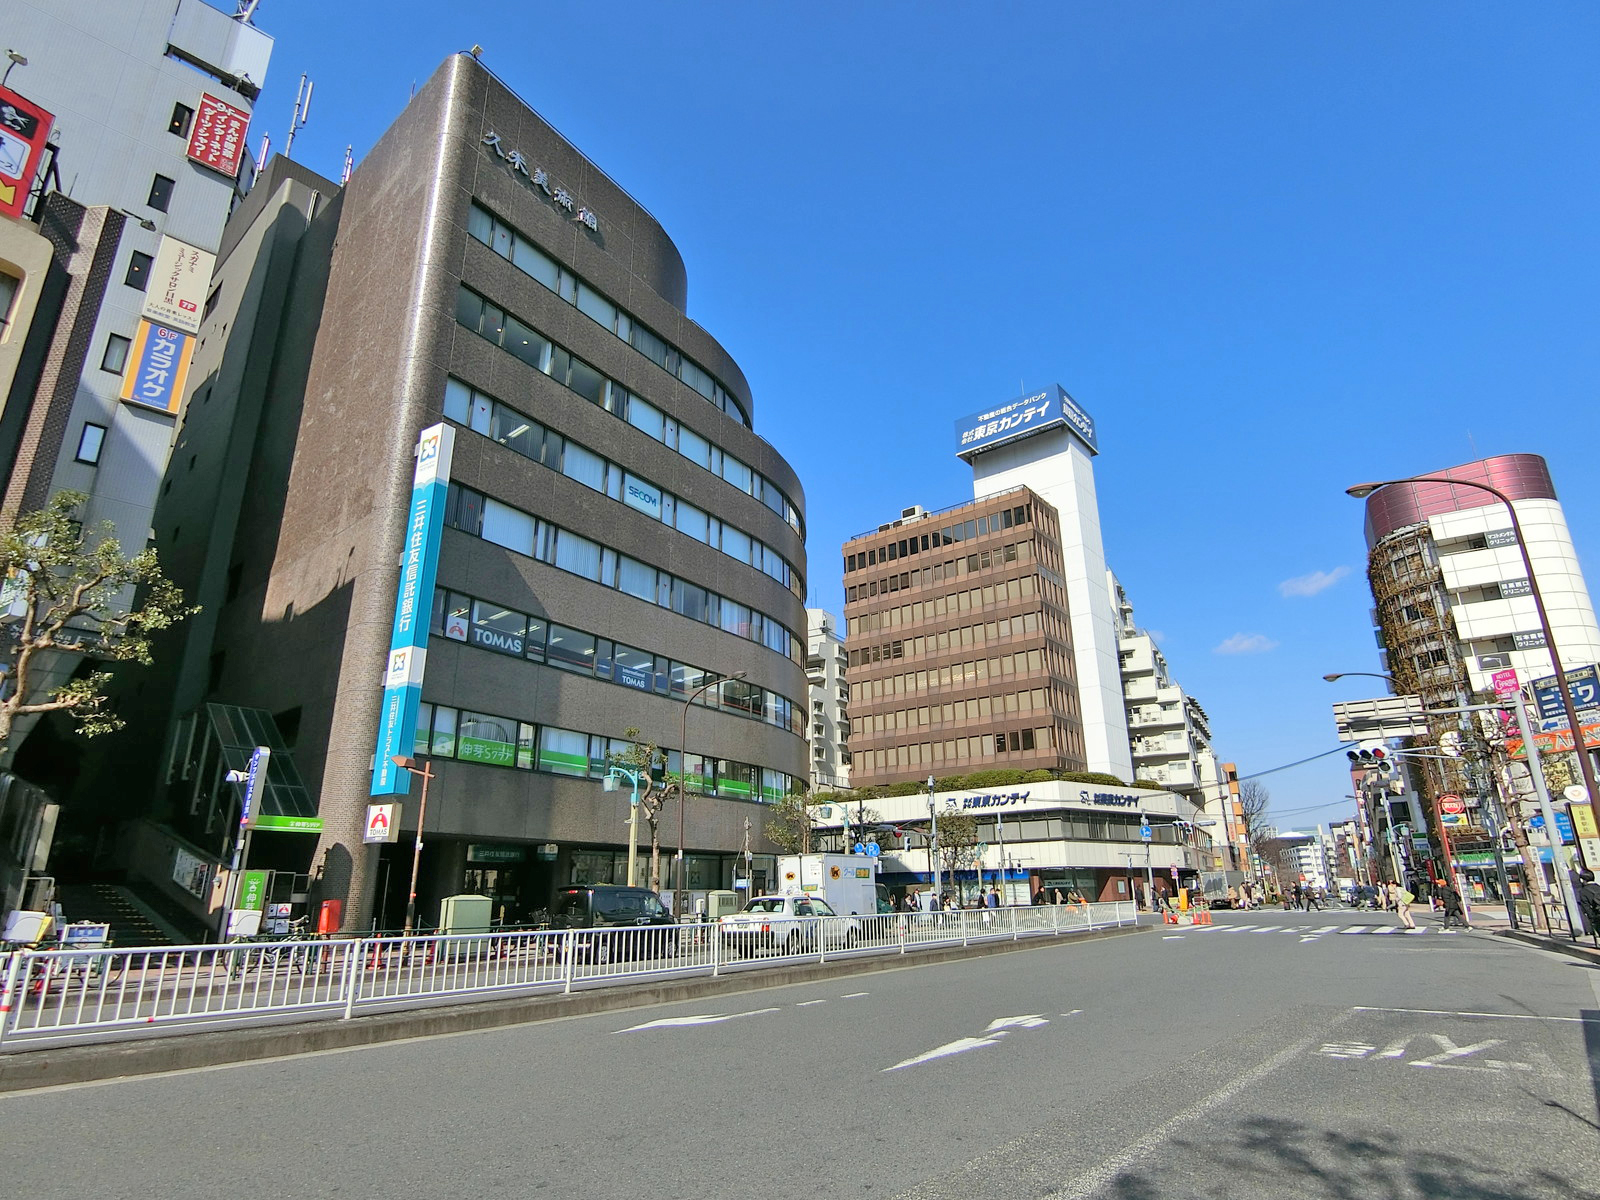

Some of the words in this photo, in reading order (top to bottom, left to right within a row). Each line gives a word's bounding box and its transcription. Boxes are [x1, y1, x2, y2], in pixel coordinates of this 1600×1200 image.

[216, 102, 235, 116] 9F
[208, 115, 228, 162] インターネット
[222, 120, 241, 159] まんが喫茶
[480, 128, 598, 232] 久米美術館
[188, 251, 200, 274] スガナミ
[163, 247, 185, 306] ミュージックサロン目黒
[181, 301, 195, 312] 7F
[157, 328, 178, 341] 6F
[142, 338, 176, 398] カラオケ
[973, 400, 1051, 441] 東京カンテイ
[628, 485, 657, 507] SECOM
[1489, 537, 1516, 545] クリニック
[399, 499, 428, 633] 三井住友信託銀行
[1503, 587, 1530, 595] クリニック
[474, 627, 522, 653] TOMAS
[1517, 639, 1546, 647] クリニック
[622, 675, 645, 688] TOMAS
[972, 791, 1031, 809] 東京カンテイ
[370, 828, 388, 836] TOMAS
